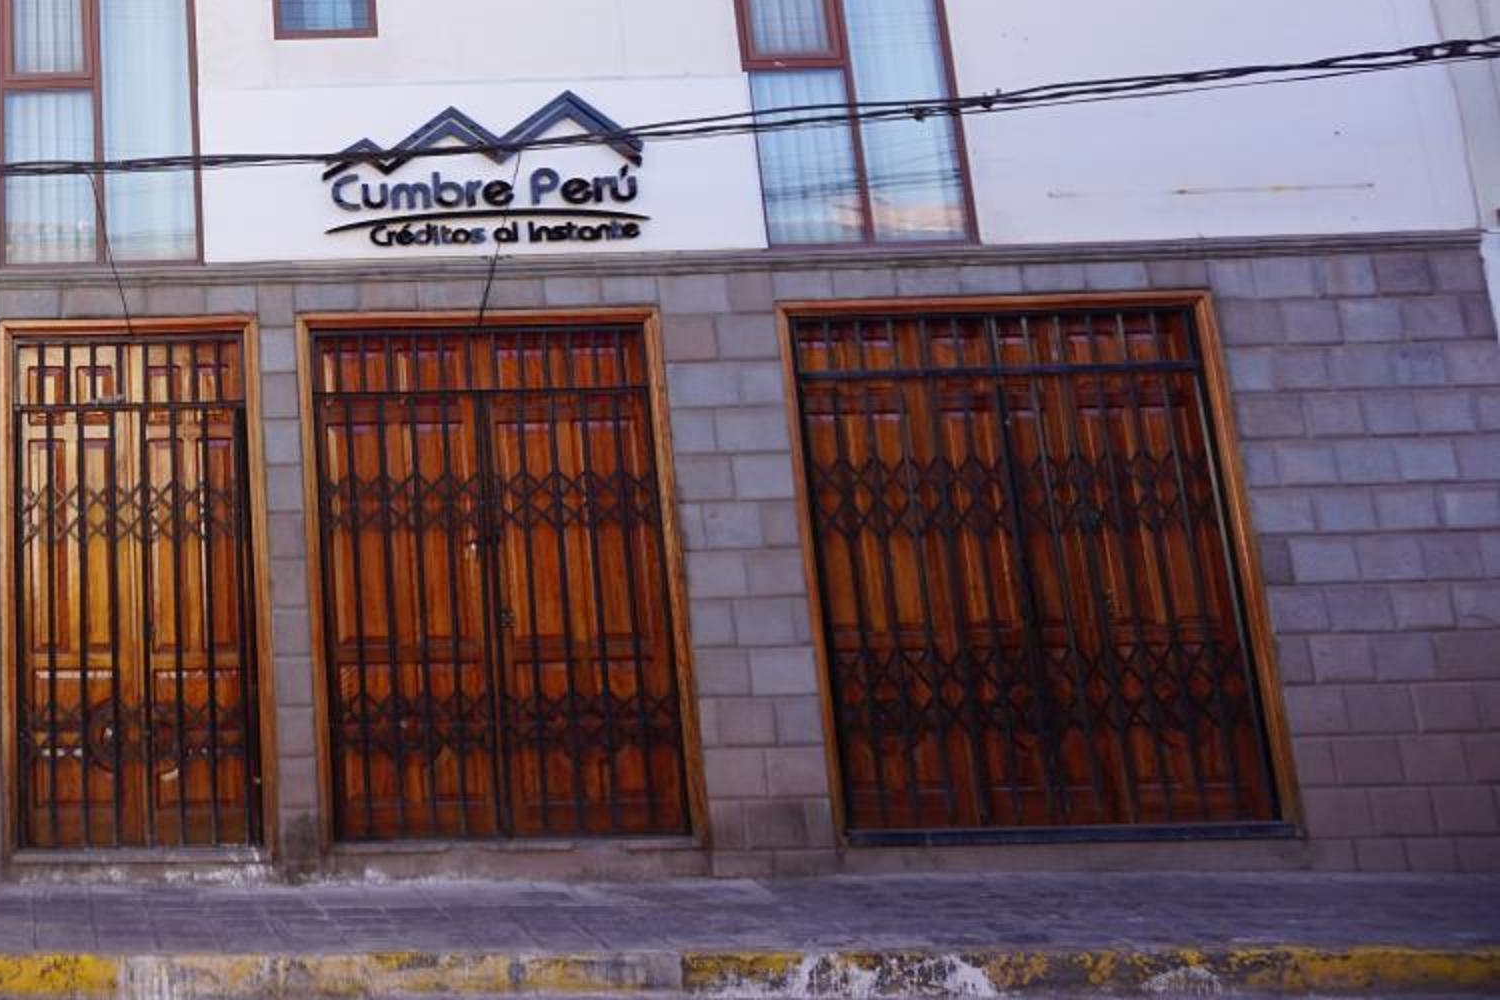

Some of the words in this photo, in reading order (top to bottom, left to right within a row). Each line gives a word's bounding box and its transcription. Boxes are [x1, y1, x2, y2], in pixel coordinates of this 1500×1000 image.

[331, 172, 514, 211] Cumbre
[529, 165, 638, 206] Perú
[369, 224, 486, 248] Créditos
[493, 222, 519, 243] al
[528, 221, 641, 243] Instante
